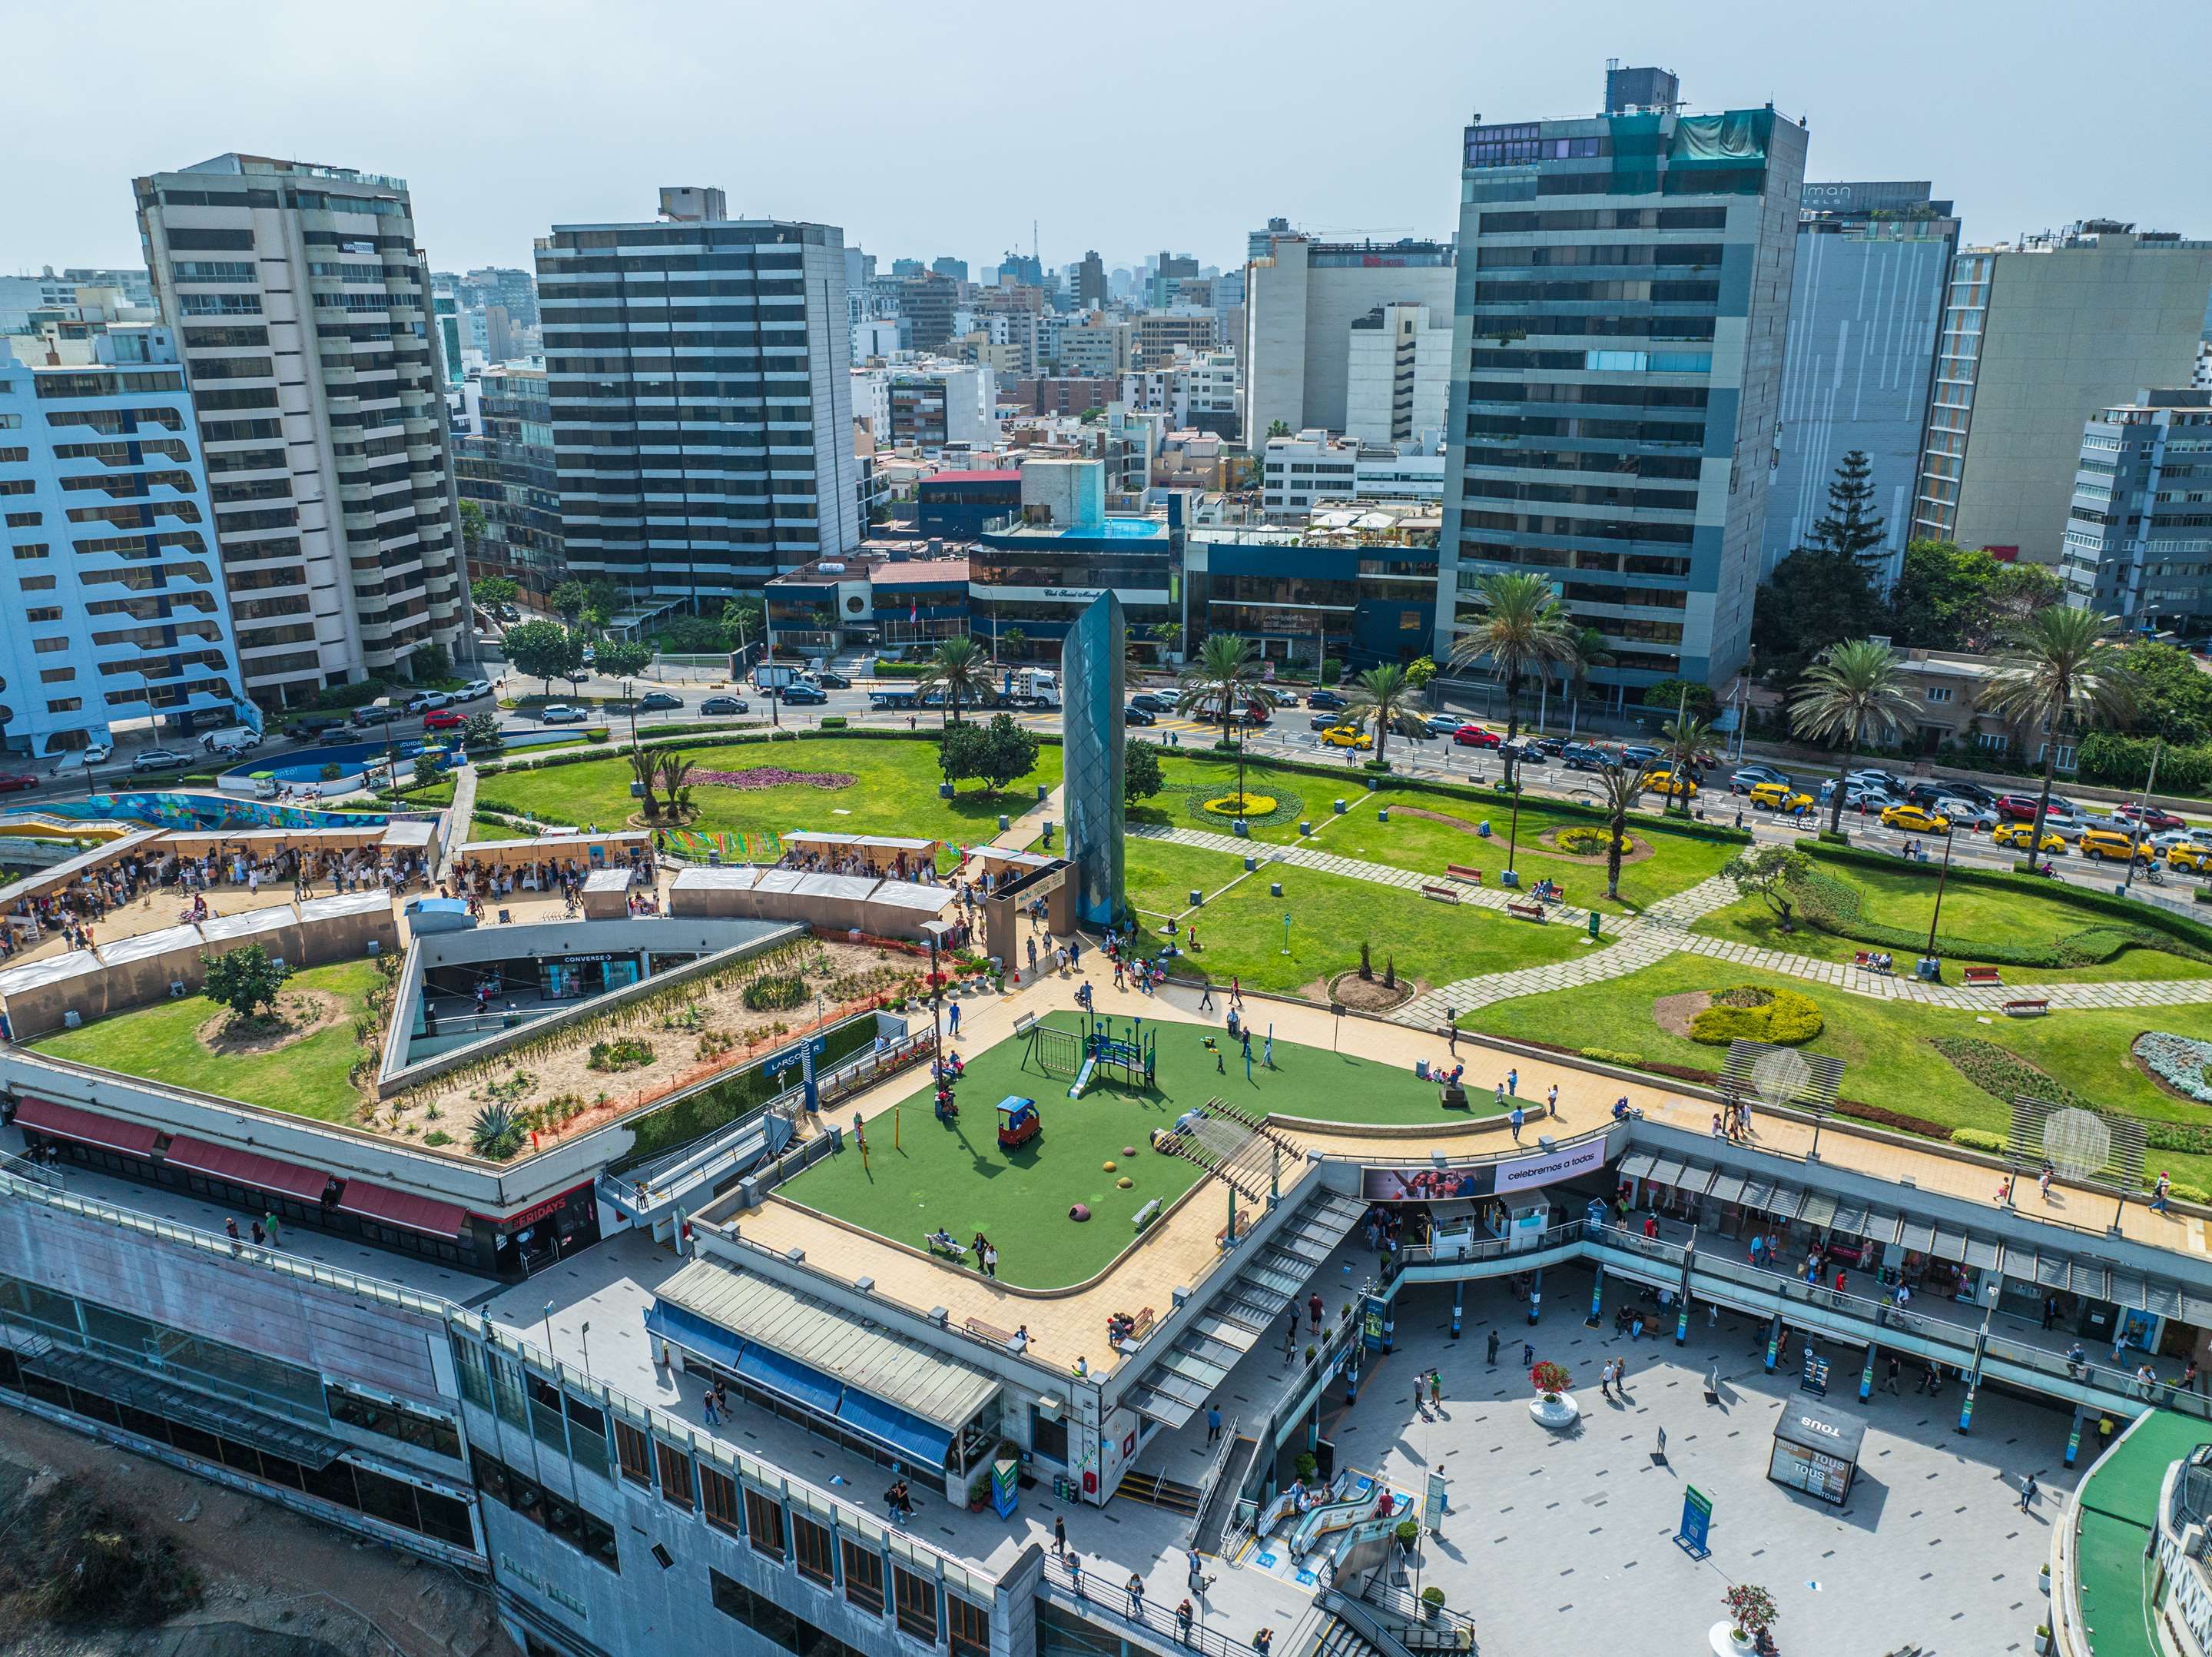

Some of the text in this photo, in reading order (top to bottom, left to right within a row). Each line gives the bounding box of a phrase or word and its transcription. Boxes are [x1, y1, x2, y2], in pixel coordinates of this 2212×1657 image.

[1802, 184, 1851, 199] lman
[274, 767, 298, 779] onto!
[565, 955, 605, 963] CONVERSE
[771, 1044, 820, 1071] LARCOR
[1507, 1162, 1562, 1181] celebremos
[1571, 1153, 1595, 1166] todas
[519, 1198, 566, 1226] FRIDAYS
[1801, 1416, 1839, 1437] TOUS
[1777, 1440, 1799, 1451] TOUS
[1812, 1460, 1833, 1473] TOUS
[1813, 1453, 1845, 1471] TOUS
[1795, 1462, 1826, 1480] TOUS
[1822, 1491, 1842, 1503] TOUS
